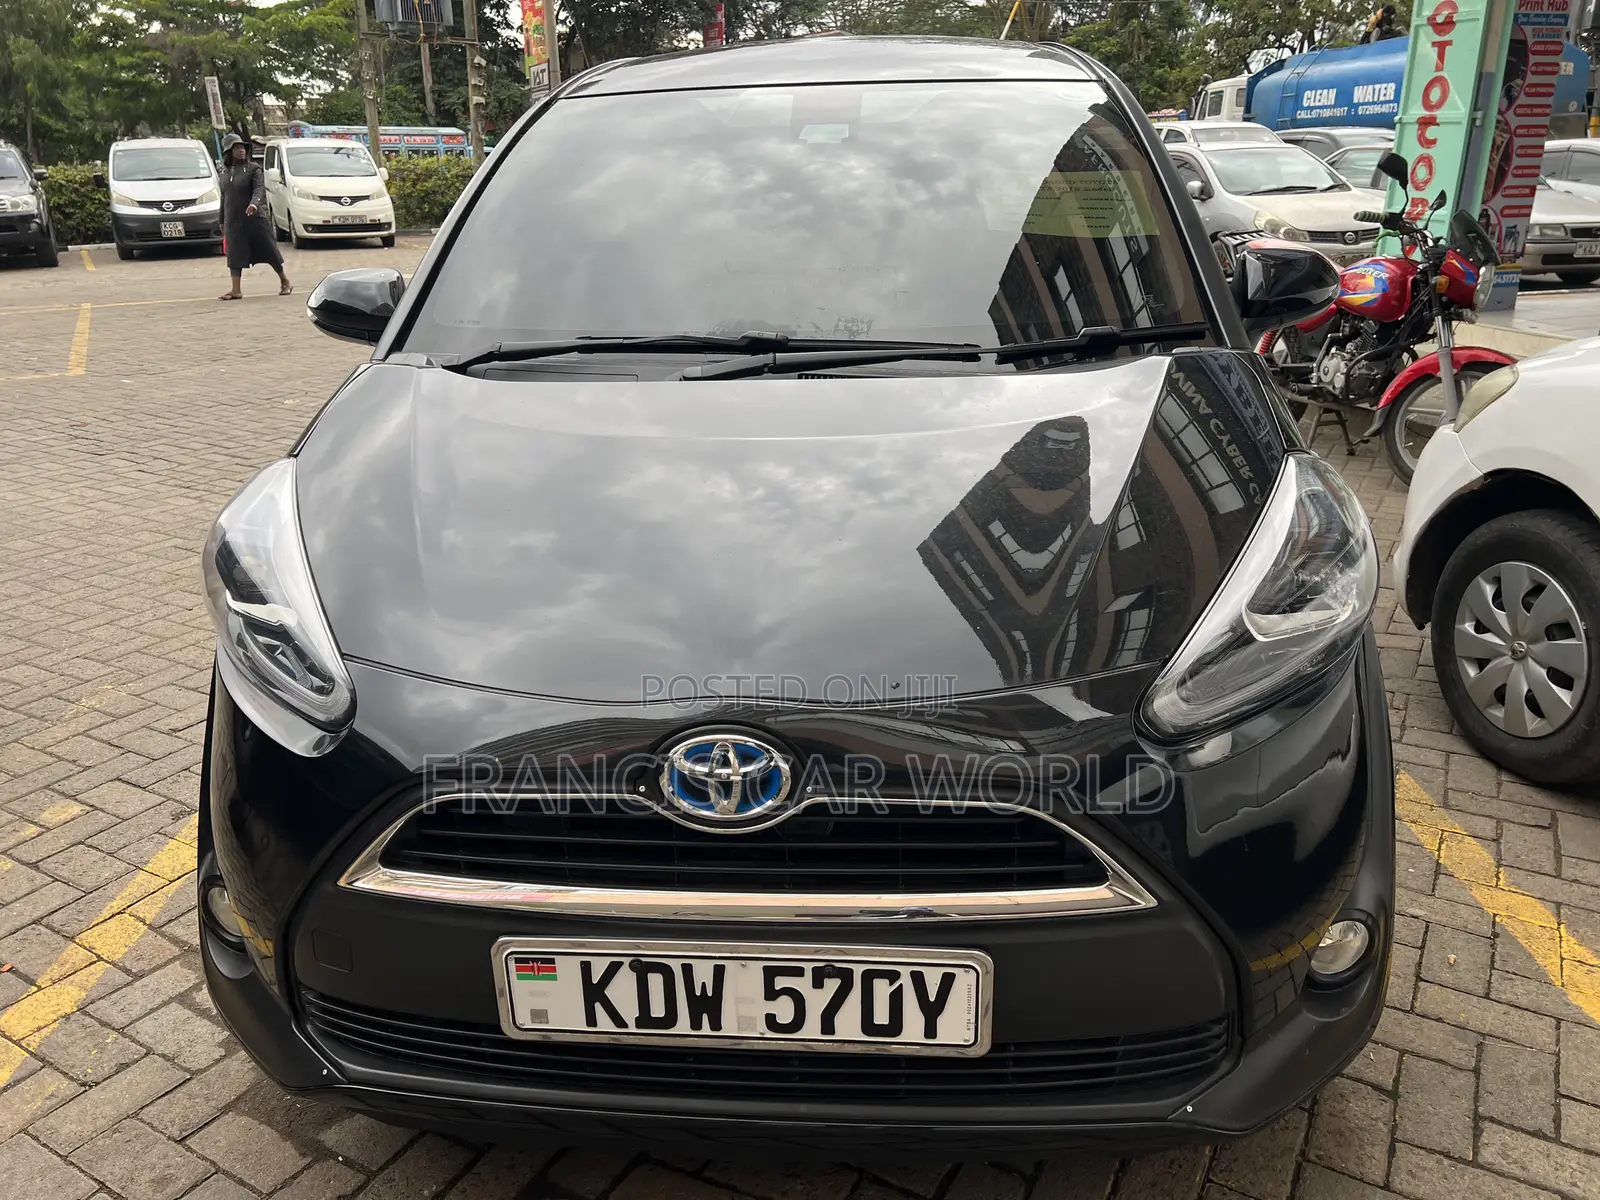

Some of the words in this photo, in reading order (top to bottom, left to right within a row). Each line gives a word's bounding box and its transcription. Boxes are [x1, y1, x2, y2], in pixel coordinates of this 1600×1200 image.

[1518, 0, 1543, 11] Print
[1547, 0, 1568, 11] Hub
[1303, 88, 1337, 107] CLEAN
[1353, 82, 1396, 103] WATER
[1356, 267, 1389, 279] BOXER
[580, 959, 726, 1032] KDW
[763, 964, 957, 1040] 570Y
